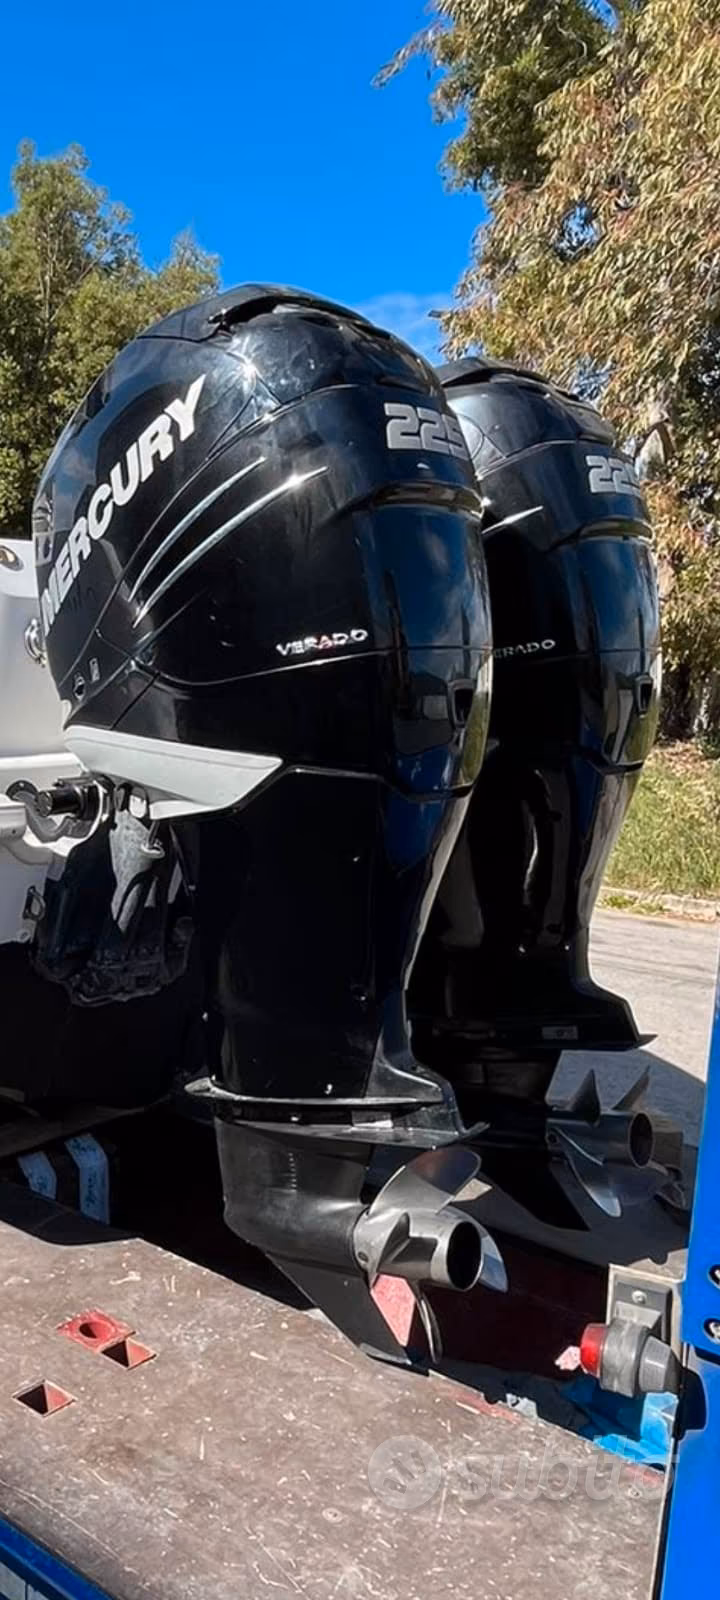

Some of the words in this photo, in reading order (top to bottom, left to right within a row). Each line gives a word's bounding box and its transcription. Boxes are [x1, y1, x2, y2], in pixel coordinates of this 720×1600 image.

[40, 374, 206, 637] MERCURY
[276, 629, 368, 655] VERADO
[493, 639, 556, 659] ERADO
